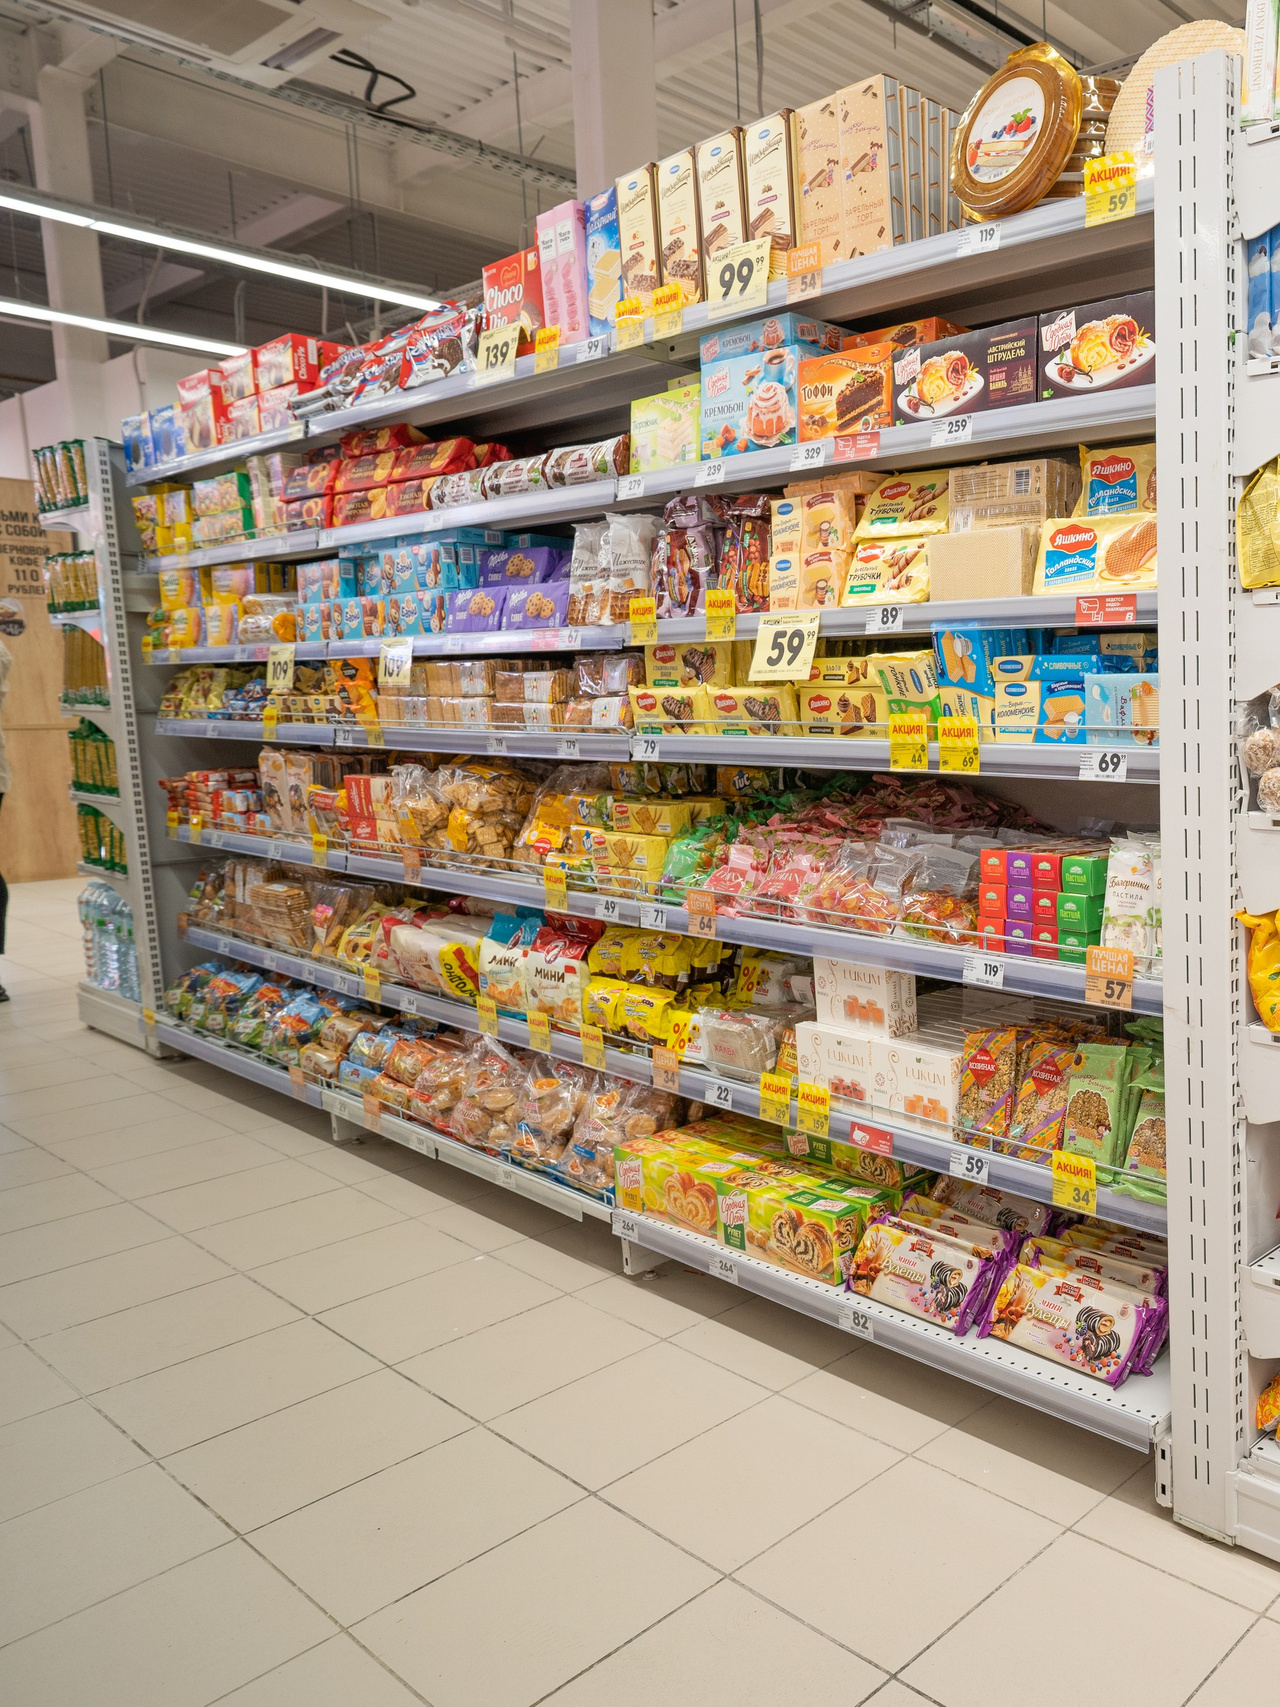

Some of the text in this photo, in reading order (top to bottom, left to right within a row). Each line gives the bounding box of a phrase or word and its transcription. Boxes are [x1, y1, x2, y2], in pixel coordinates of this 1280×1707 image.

[1089, 166, 1131, 185] АКЦИЯ!
[845, 198, 885, 218] ВАФЕЛЬНЫЙ
[1108, 193, 1127, 213] 59
[802, 212, 840, 231] ВАФЕЛЬНЫЙ
[857, 212, 874, 223] ТОРТ
[813, 225, 829, 237] ТОРТ
[979, 228, 995, 243] 119
[790, 246, 817, 261] ЛУЧШАЯ
[790, 255, 818, 271] ЦЕНА!
[719, 255, 765, 301] 99 99
[800, 272, 816, 293] 54
[486, 283, 523, 312] Choco
[655, 292, 678, 307] АКЦИЯ!
[667, 319, 678, 329] 179
[538, 332, 558, 346] АКЦИЯ!
[722, 334, 751, 349] КРЕМОБОН
[587, 340, 599, 354] 99
[987, 339, 1025, 354] АВСТРИЙСКИЙ
[485, 341, 509, 370] 139
[987, 348, 1025, 363] ШТРУДЕЛЬ
[704, 403, 744, 418] КРЕМОБОН
[948, 419, 967, 435] 259
[804, 447, 821, 460] 329
[706, 465, 722, 477] 239
[1092, 462, 1132, 475] ЯШКИНО
[628, 479, 641, 491] 279
[1089, 486, 1136, 506] Голландские
[870, 506, 906, 515] ТРУБОЧКИ
[1054, 531, 1094, 546] ЯШКИНО
[9, 556, 39, 567] КОФЕ
[1045, 555, 1095, 577] Голландские
[15, 569, 39, 582] 110
[488, 572, 502, 581] COOKIE
[849, 573, 881, 581] ТРУБОЧКИ
[632, 607, 653, 616] АКЦИЯ!
[708, 600, 732, 609] АКЦИЯ!
[881, 607, 898, 625] 89
[568, 630, 578, 643] 67
[646, 628, 654, 639] 49
[722, 625, 731, 635] 49
[767, 629, 816, 666] 59 99
[272, 662, 287, 680] 109
[382, 654, 403, 678] 109
[1049, 661, 1082, 670] СЛИВОЧНЫЕ
[810, 700, 831, 709] ЯШКИНО
[997, 706, 1035, 718] КОЛОМЕНСКИЕ
[892, 724, 923, 736] АКЦИЯ!
[941, 727, 975, 739] АКЦИЯ!
[565, 740, 576, 750] 179
[644, 740, 656, 755] 79
[911, 754, 922, 765] 44
[962, 755, 974, 768] 69
[1098, 753, 1121, 773] 69
[410, 870, 419, 880] 59
[545, 874, 564, 885] АКЦИЯ!
[690, 893, 711, 903] ЛУЧШАЯ
[1112, 892, 1143, 900] ПАСТИЛА
[604, 900, 616, 914] 49
[690, 900, 712, 911] ЦЕНА!
[653, 909, 664, 923] 71
[699, 916, 712, 931] 64
[1092, 949, 1128, 963] ЛУЧШАЯ
[535, 967, 565, 983] МИНИ
[984, 963, 998, 977] 119
[1092, 961, 1128, 976] ЦЕНА!
[843, 969, 881, 986] LUKUM
[1104, 981, 1126, 1000] 57
[478, 1003, 495, 1014] АКЦИЯ!
[529, 1018, 546, 1028] АКЦИЯ!
[582, 1031, 600, 1044] АКЦИЯ!
[827, 1050, 864, 1067] LUKUM
[969, 1062, 996, 1072] КОЗИНАК
[663, 1070, 676, 1084] 34
[905, 1066, 947, 1086] LUKUM
[1032, 1071, 1063, 1083] КОЗИНАК
[716, 1086, 729, 1102] 22
[763, 1082, 788, 1096] АКЦИЯ!
[801, 1091, 827, 1106] АКЦИЯ!
[775, 1107, 786, 1119] 129
[812, 1119, 824, 1131] 159
[966, 1157, 984, 1175] 59
[1056, 1162, 1092, 1179] АКЦИЯ!
[625, 1192, 637, 1200] РУЛЕТ
[1073, 1188, 1090, 1205] 34
[622, 1221, 634, 1232] 264
[727, 1228, 741, 1238] РУЛЕТ
[719, 1261, 734, 1275] 264
[881, 1258, 925, 1284] Рулеты
[852, 1312, 869, 1331] 82
[1023, 1301, 1071, 1329] Рулеты
